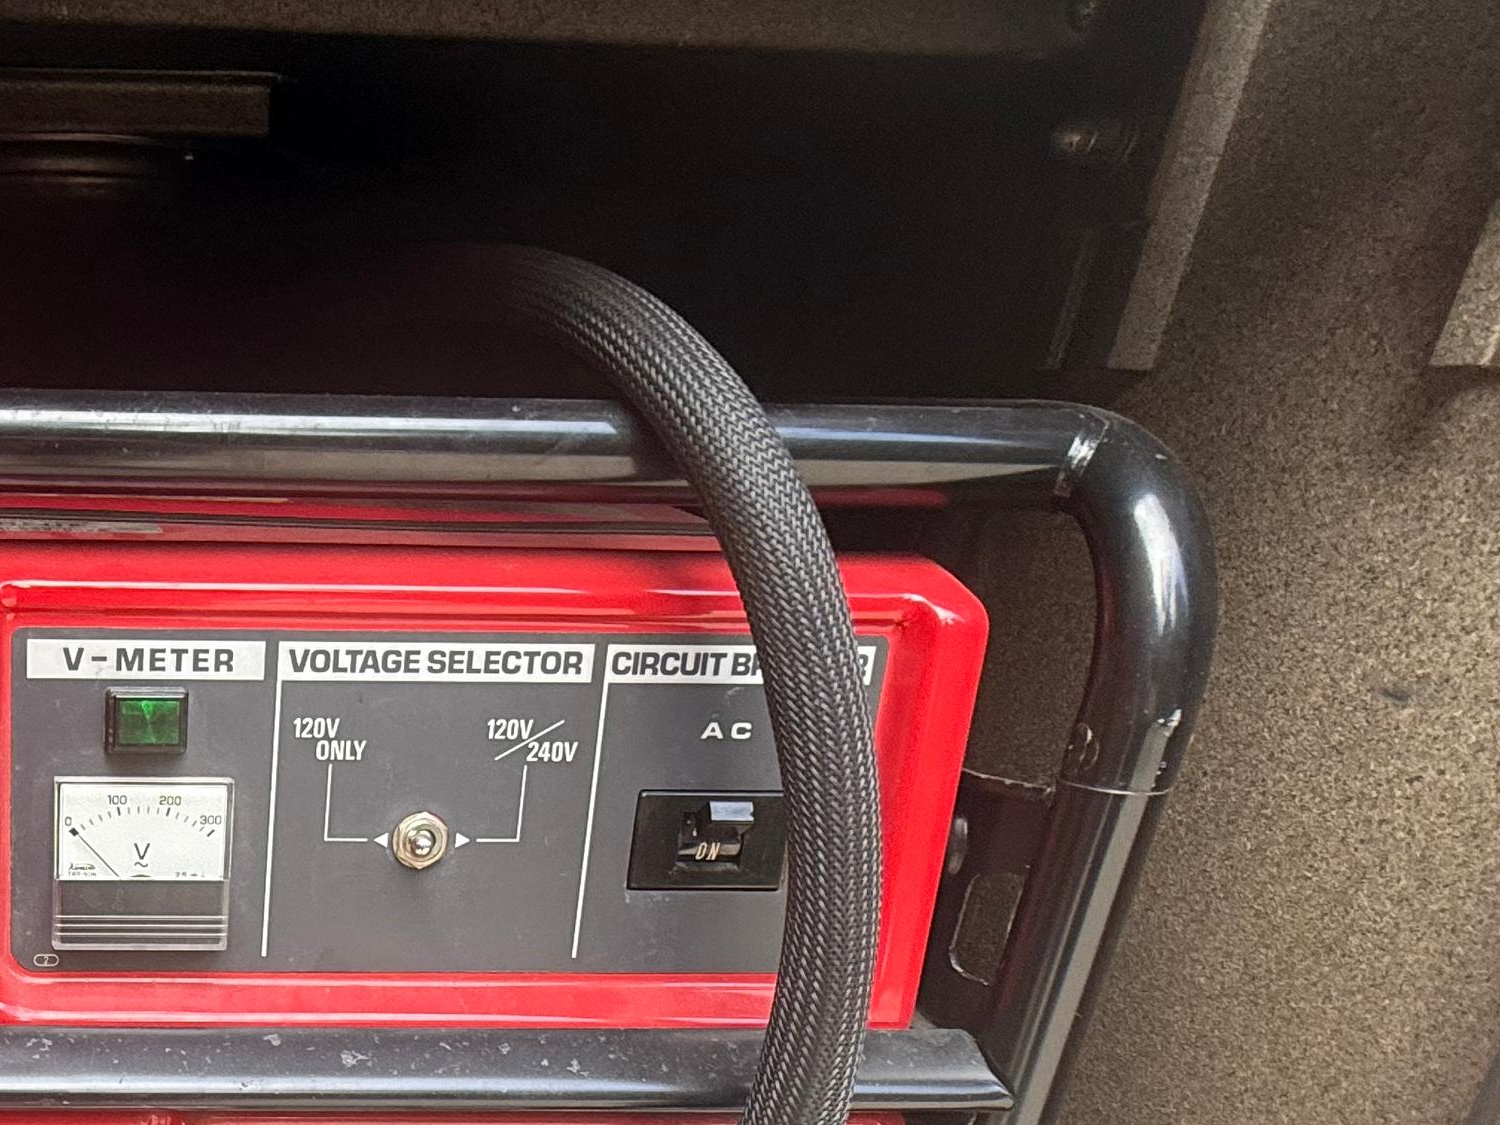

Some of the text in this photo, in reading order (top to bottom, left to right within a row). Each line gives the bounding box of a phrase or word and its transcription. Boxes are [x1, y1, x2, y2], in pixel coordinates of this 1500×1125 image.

[288, 649, 584, 676] VOLTAGE SELECTOR
[611, 652, 728, 677] CIRCUIT
[293, 717, 340, 739] 120V
[486, 718, 534, 741] 120V
[316, 740, 367, 761] ONLY
[526, 741, 579, 763] 240V
[64, 794, 222, 827] 0 100 200 300
[133, 842, 151, 861] V
[695, 842, 721, 861] ON
